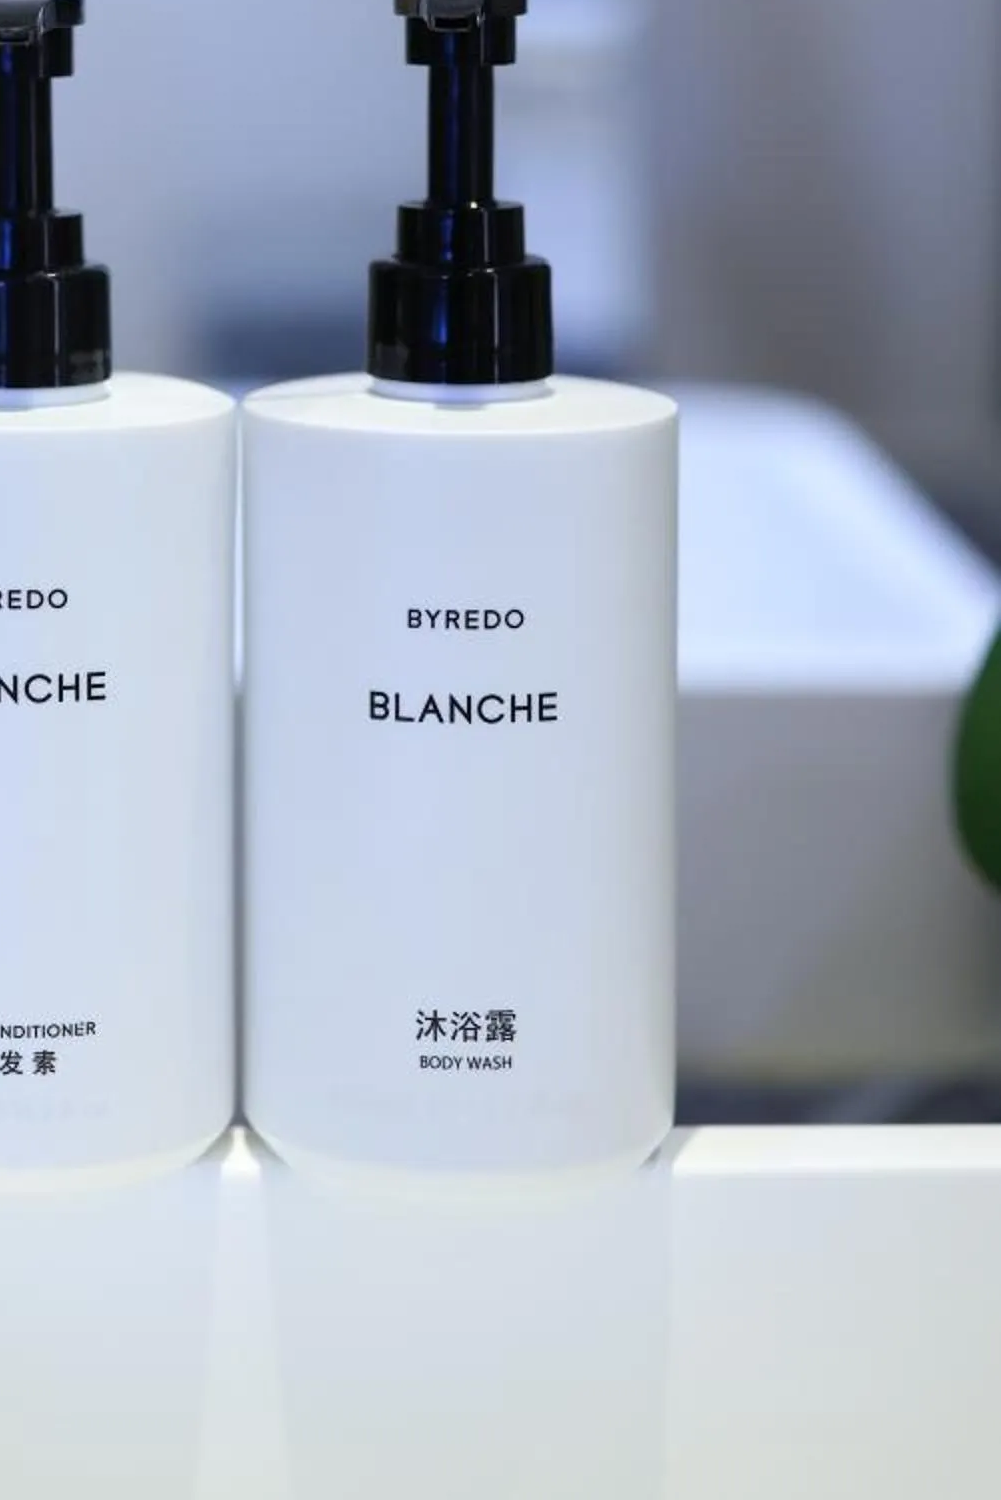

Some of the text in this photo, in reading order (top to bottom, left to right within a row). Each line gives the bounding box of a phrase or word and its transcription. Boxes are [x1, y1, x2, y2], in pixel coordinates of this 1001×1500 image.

[406, 607, 526, 630] BYREDO
[368, 689, 559, 725] BLANCHE
[415, 1008, 518, 1043] 沐浴露
[419, 1054, 513, 1071] BODY WASH
